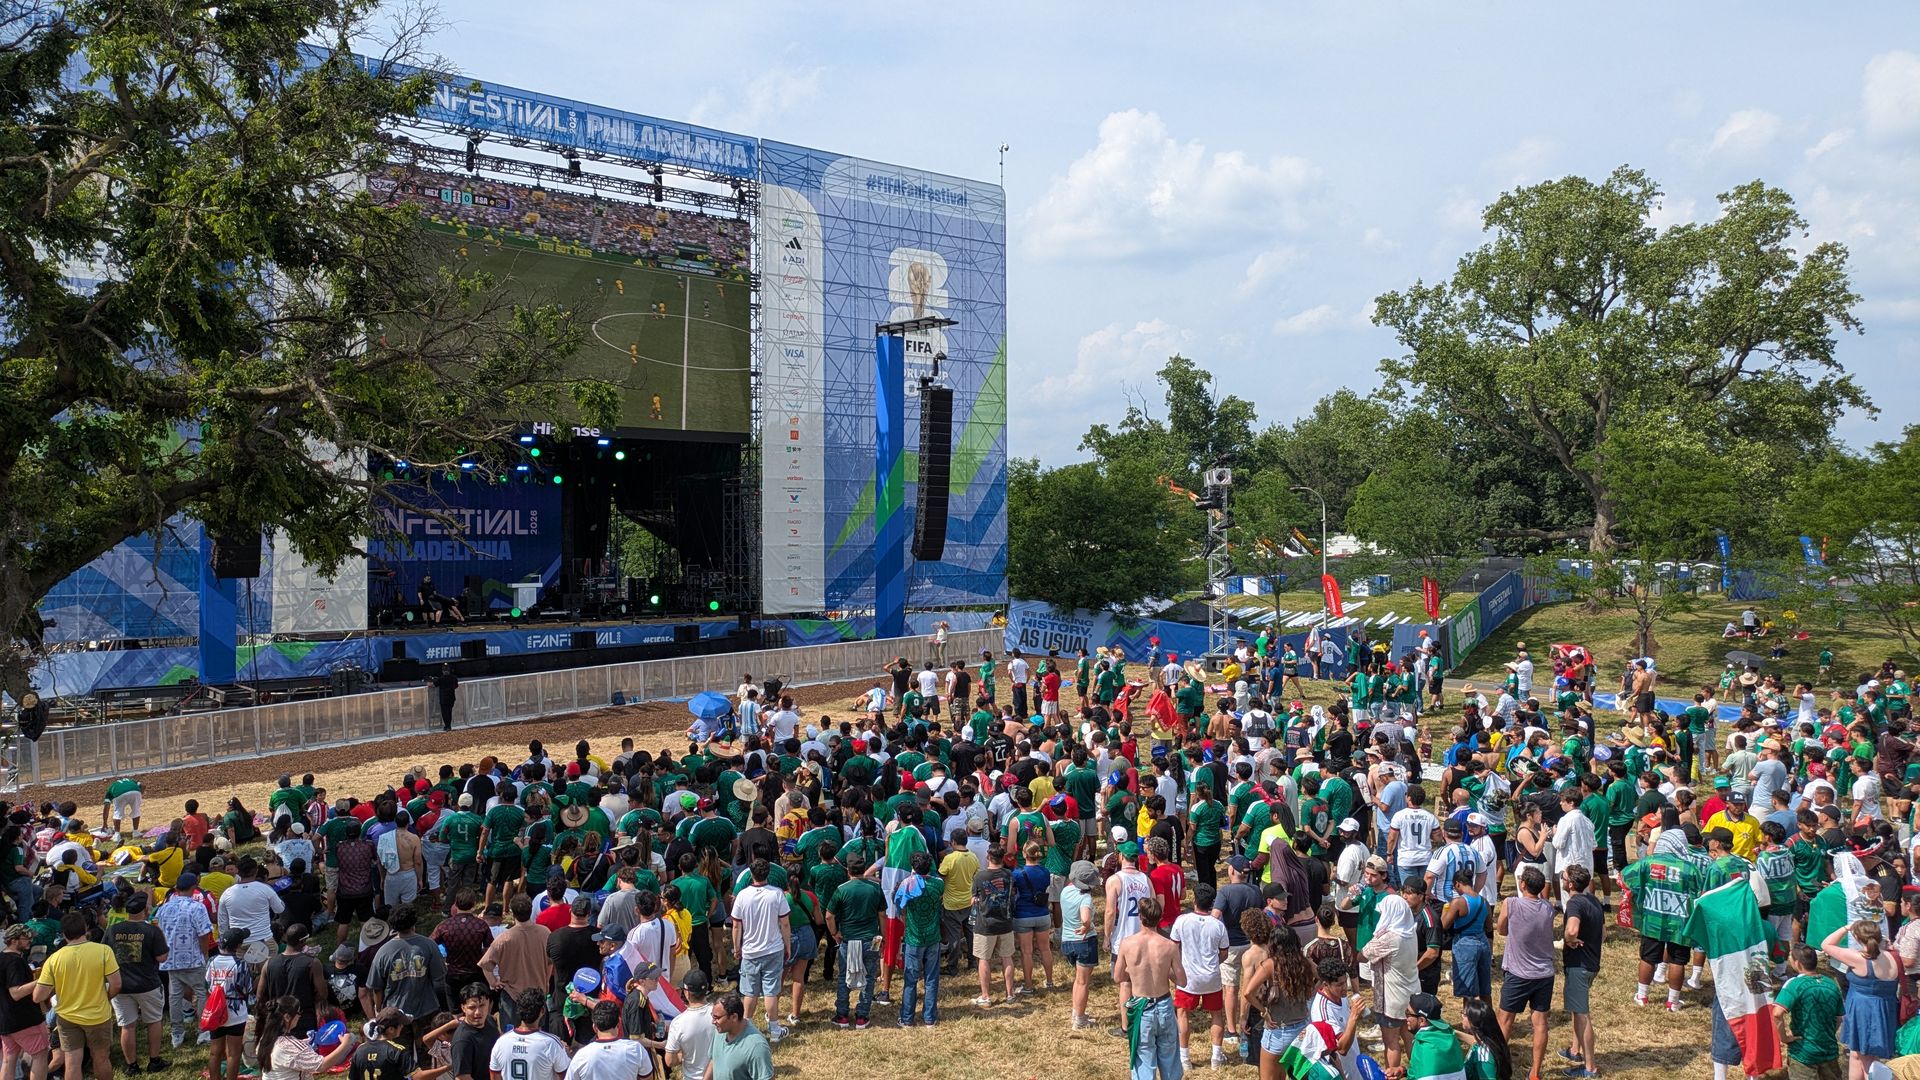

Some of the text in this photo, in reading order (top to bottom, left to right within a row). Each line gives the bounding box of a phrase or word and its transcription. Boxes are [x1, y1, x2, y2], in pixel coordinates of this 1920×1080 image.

[587, 112, 749, 168] PHILADELPHIA
[866, 173, 968, 207] #FIFAFanFestival
[784, 347, 805, 359] VISA
[905, 339, 932, 354] FIFA
[533, 421, 601, 438] Hinse
[530, 509, 538, 536] 2026
[1020, 617, 1093, 639] HISTORY,
[1038, 612, 1095, 627] MAKING
[1019, 627, 1040, 649] AS
[457, 823, 469, 842] 4
[1410, 822, 1423, 845] 4
[1643, 887, 1690, 918] MEX
[510, 1058, 528, 1080] 9
